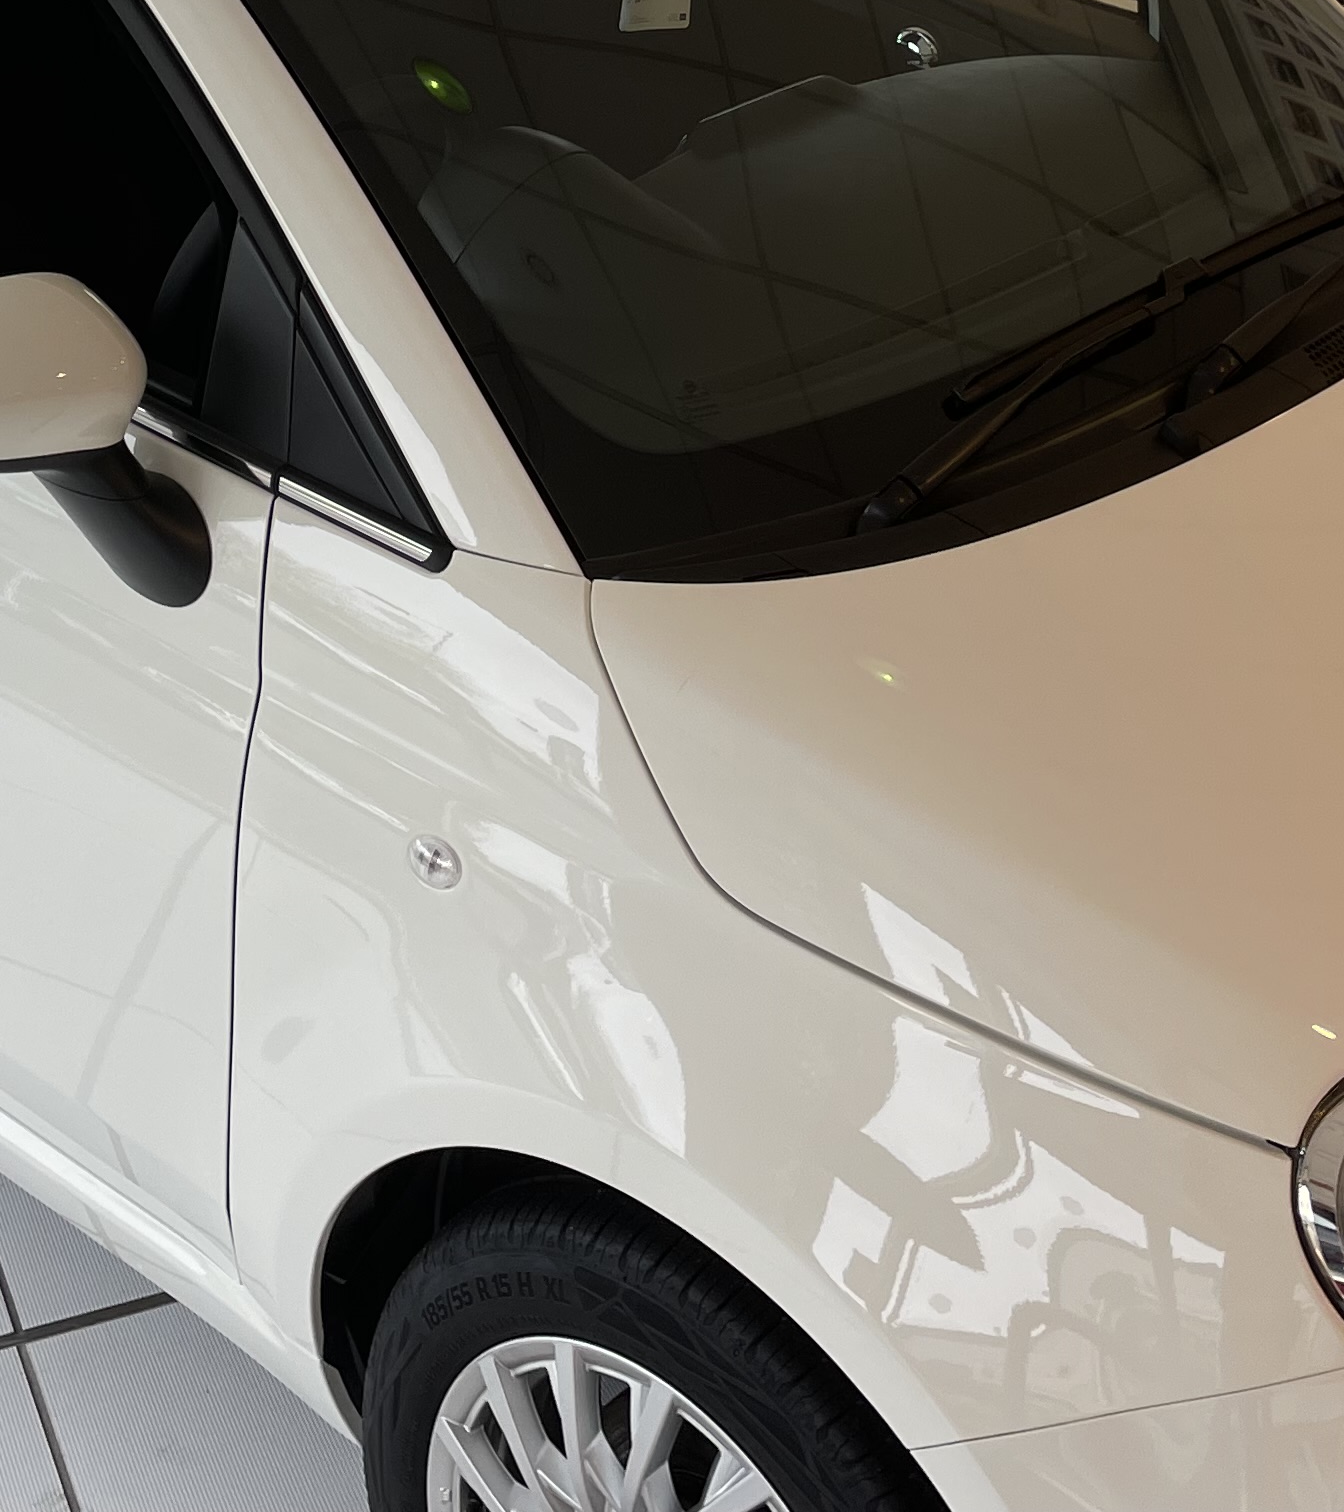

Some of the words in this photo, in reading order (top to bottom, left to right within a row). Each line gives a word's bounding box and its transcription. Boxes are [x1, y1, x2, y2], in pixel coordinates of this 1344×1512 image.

[421, 1282, 474, 1331] 185/55
[475, 1276, 492, 1302] R
[517, 1271, 535, 1298] H
